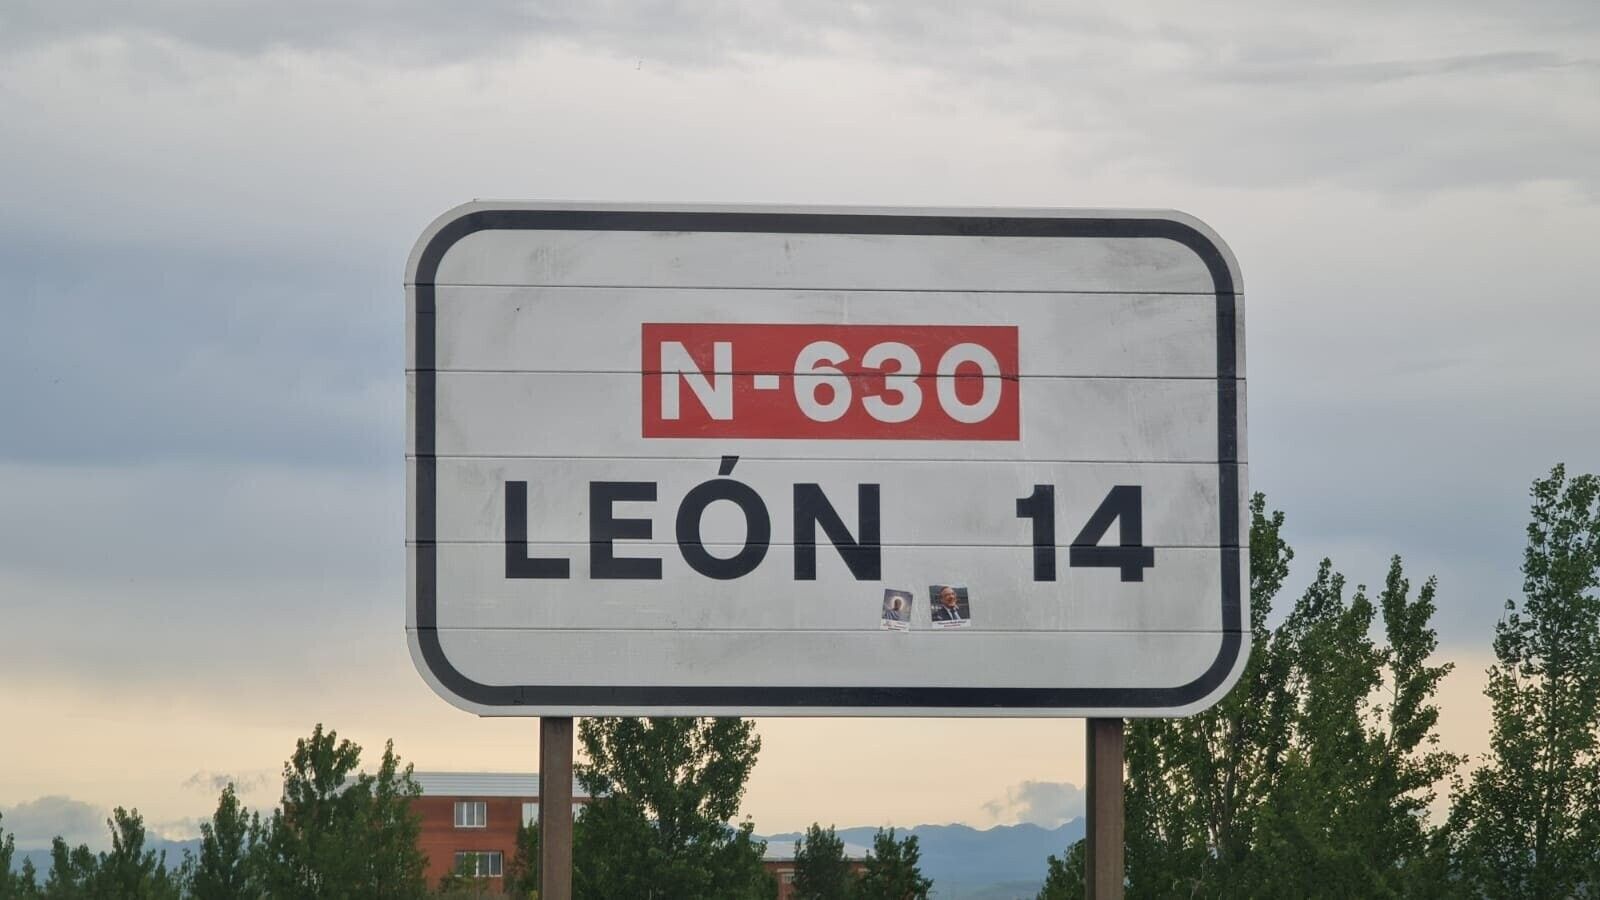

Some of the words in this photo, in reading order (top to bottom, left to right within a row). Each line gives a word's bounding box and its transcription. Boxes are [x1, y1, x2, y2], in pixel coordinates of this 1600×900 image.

[660, 341, 1003, 424] N-630
[504, 455, 882, 581] LEÓN
[1015, 484, 1155, 583] 14
